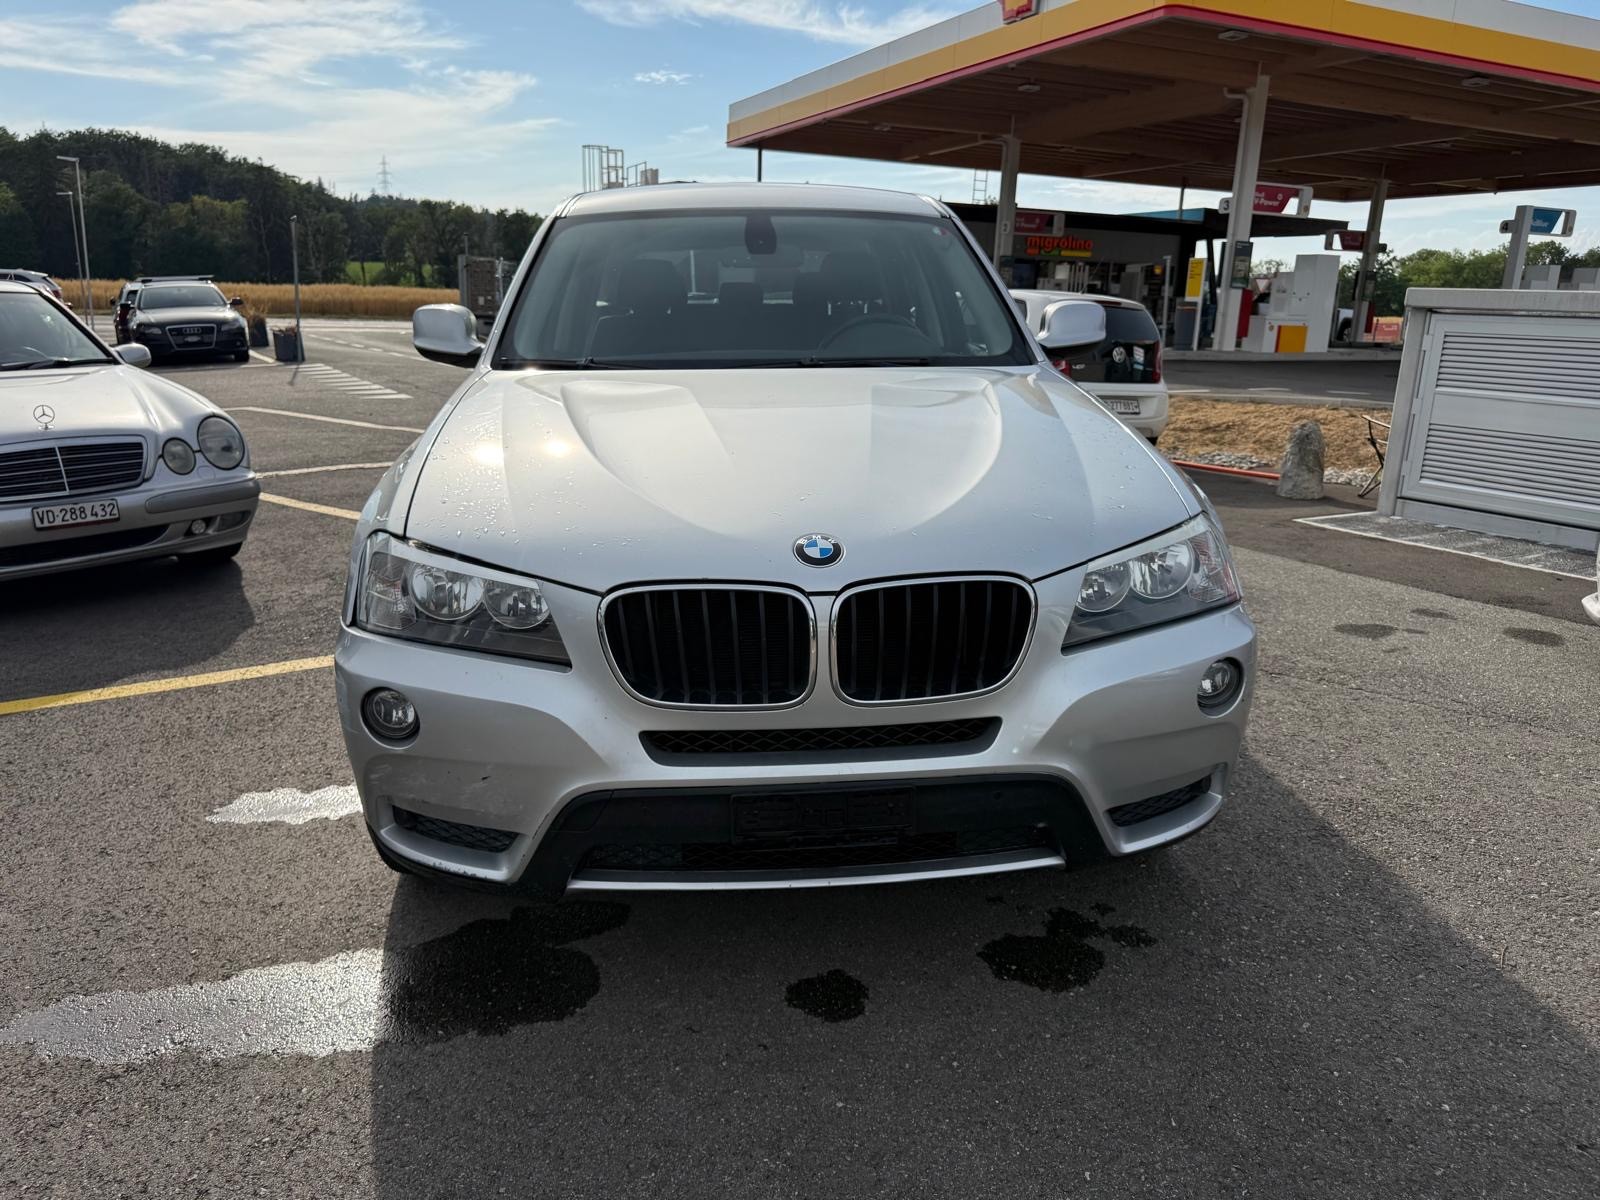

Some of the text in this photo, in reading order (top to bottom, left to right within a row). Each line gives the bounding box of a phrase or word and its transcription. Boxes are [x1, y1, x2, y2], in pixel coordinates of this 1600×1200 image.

[1223, 199, 1230, 211] 3
[1502, 222, 1509, 231] 4
[1025, 235, 1094, 254] migrolino
[797, 535, 838, 545] BMW
